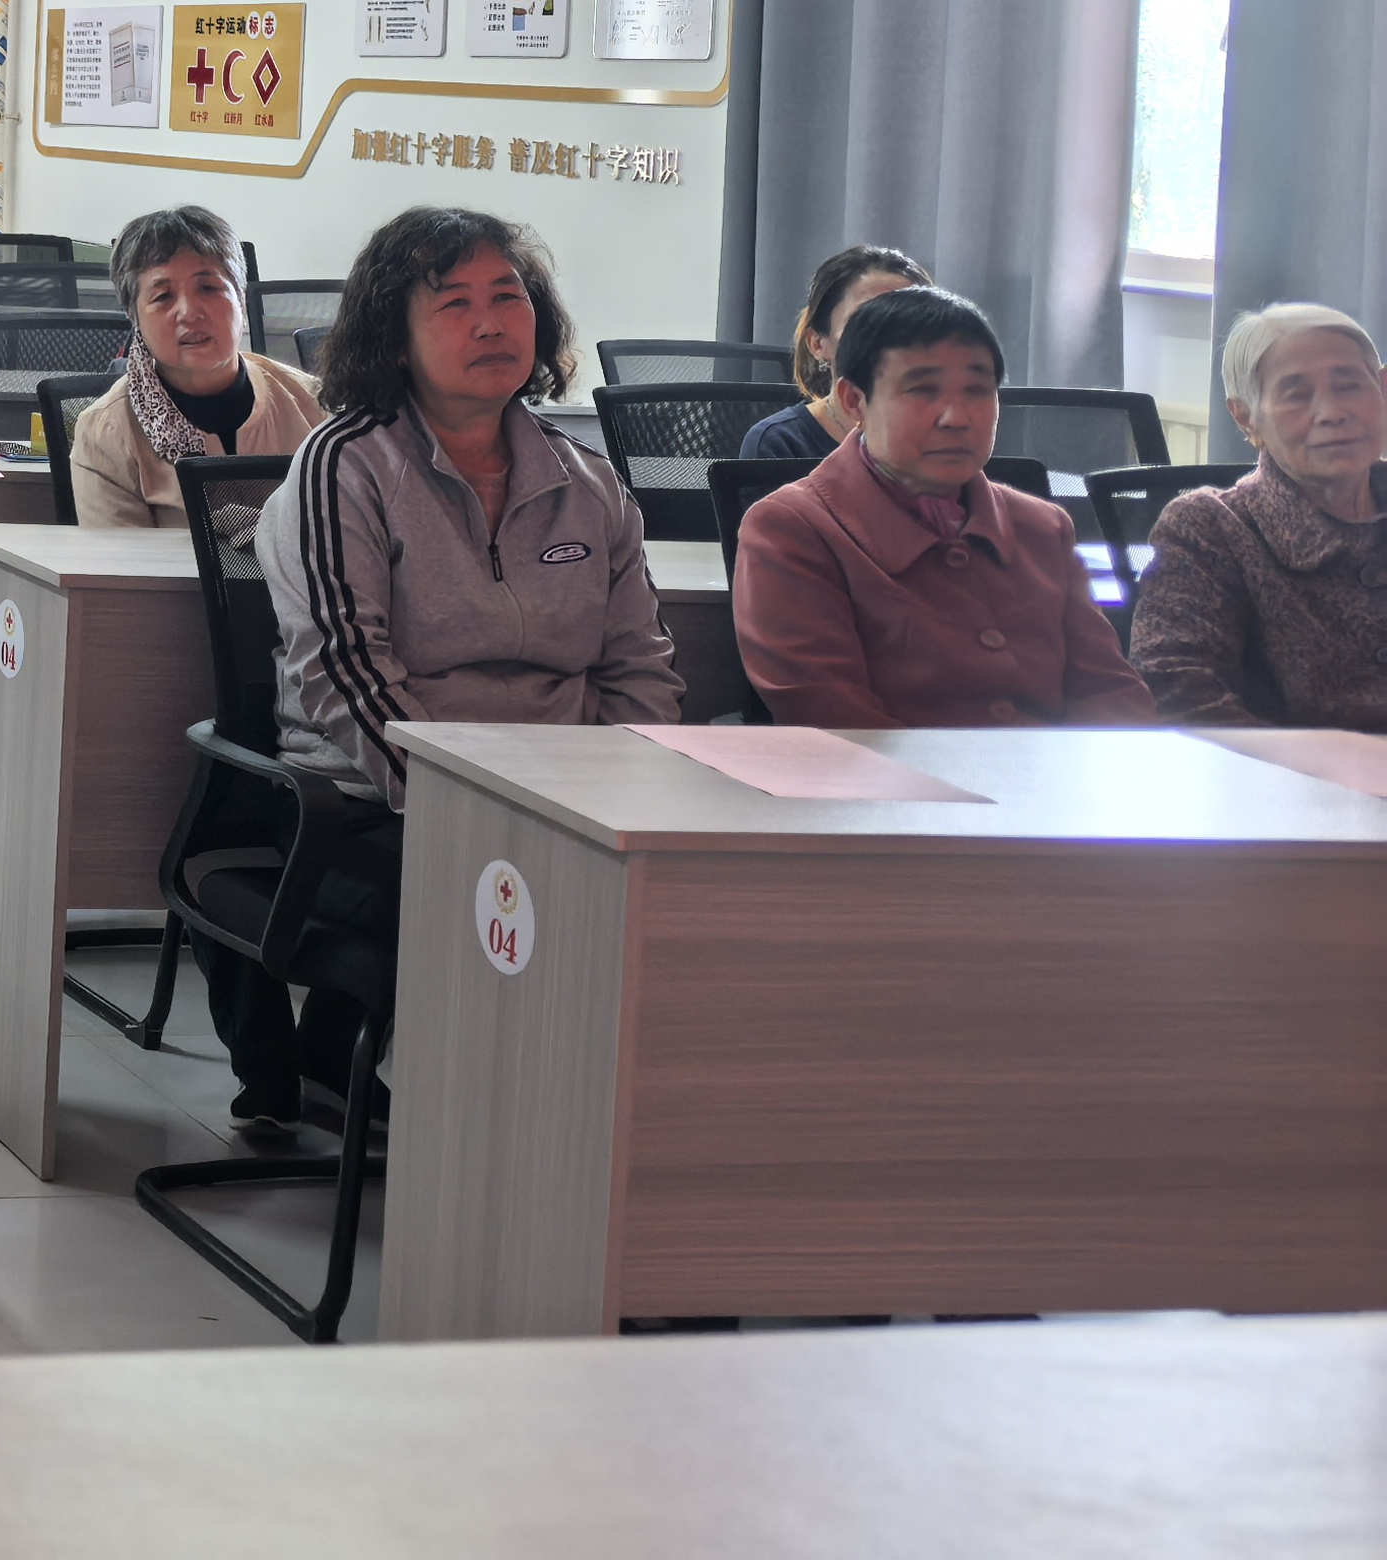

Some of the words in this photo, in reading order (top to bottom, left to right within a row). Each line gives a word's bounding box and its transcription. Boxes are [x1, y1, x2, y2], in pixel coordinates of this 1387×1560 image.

[195, 15, 275, 36] 红十字运动标志
[190, 110, 208, 123] 红十字
[224, 112, 243, 125] 红新月
[255, 114, 274, 127] 红水晶
[508, 137, 681, 187] 普及红十字知识
[1, 641, 16, 670] 04
[489, 918, 517, 965] 04
